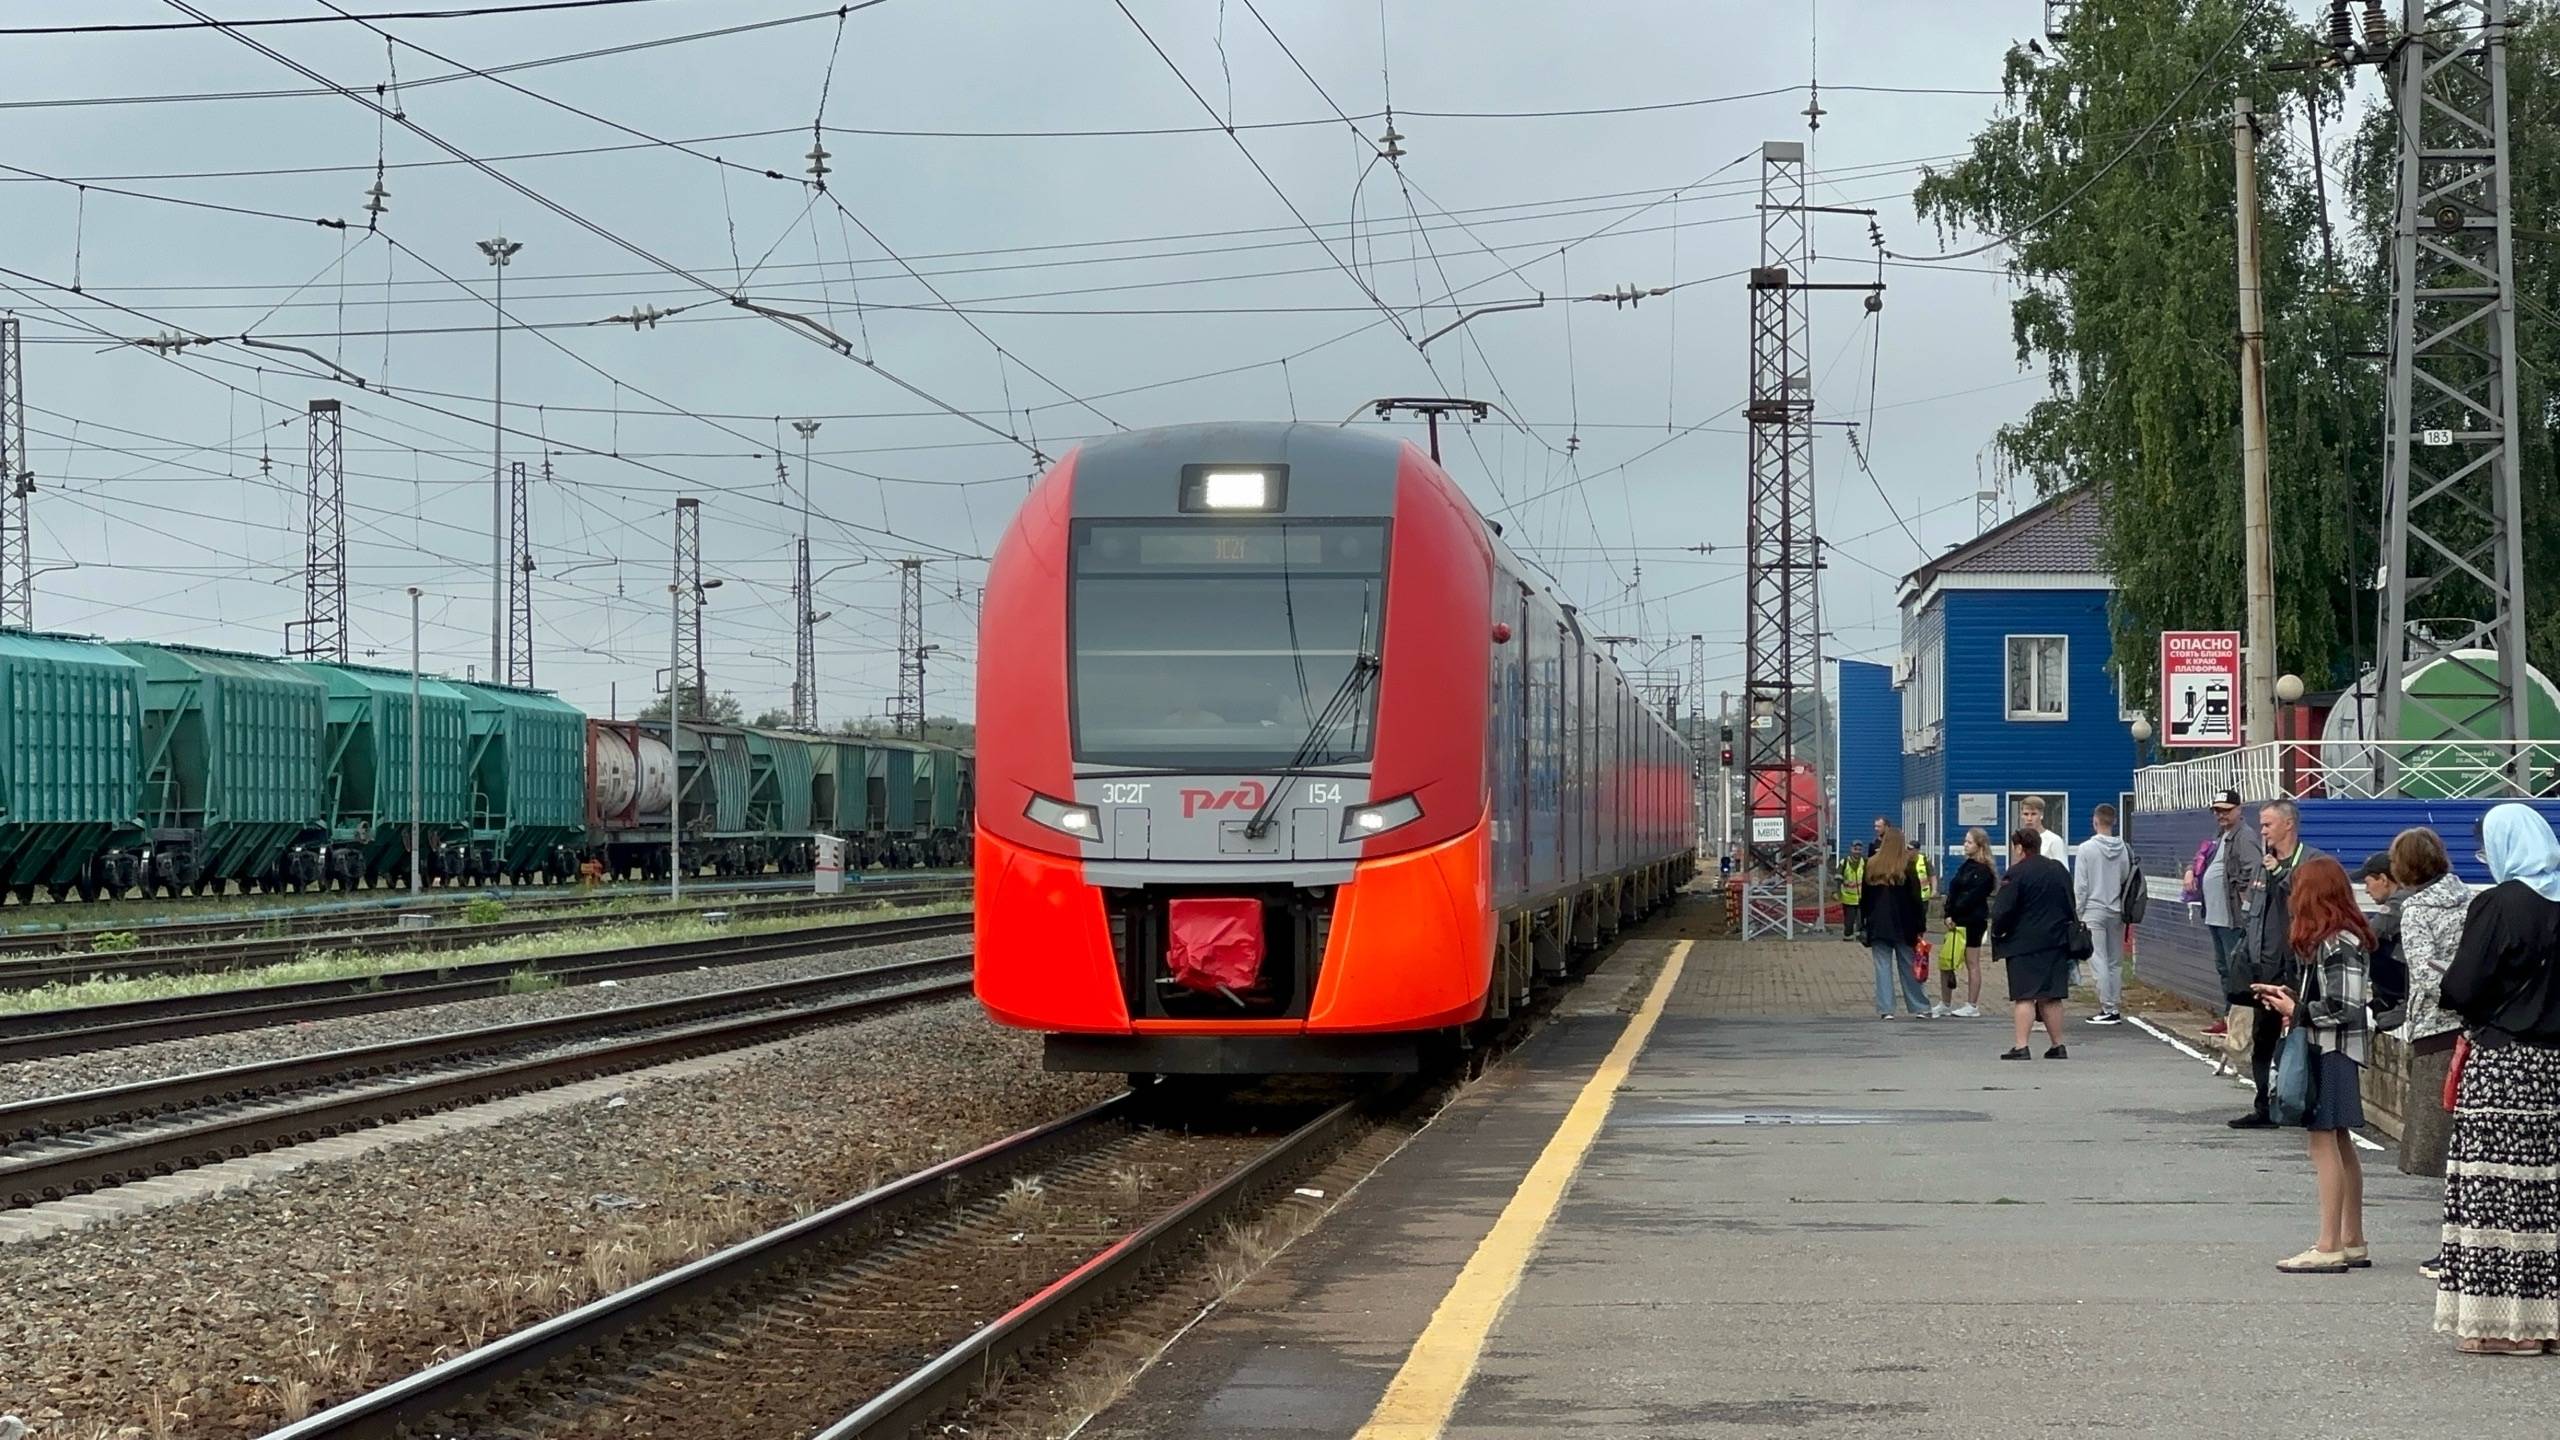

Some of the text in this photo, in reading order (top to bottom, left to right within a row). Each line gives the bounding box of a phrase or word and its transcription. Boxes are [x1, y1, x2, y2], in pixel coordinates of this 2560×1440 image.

[2427, 431, 2449, 444] 183
[2169, 638, 2233, 650] ОПАСНО
[2169, 650, 2233, 658] СТОЯТЬ БЛИЗКО
[2174, 665, 2228, 673] ПЛАТФОРМЫ
[1308, 783, 1342, 803] 154
